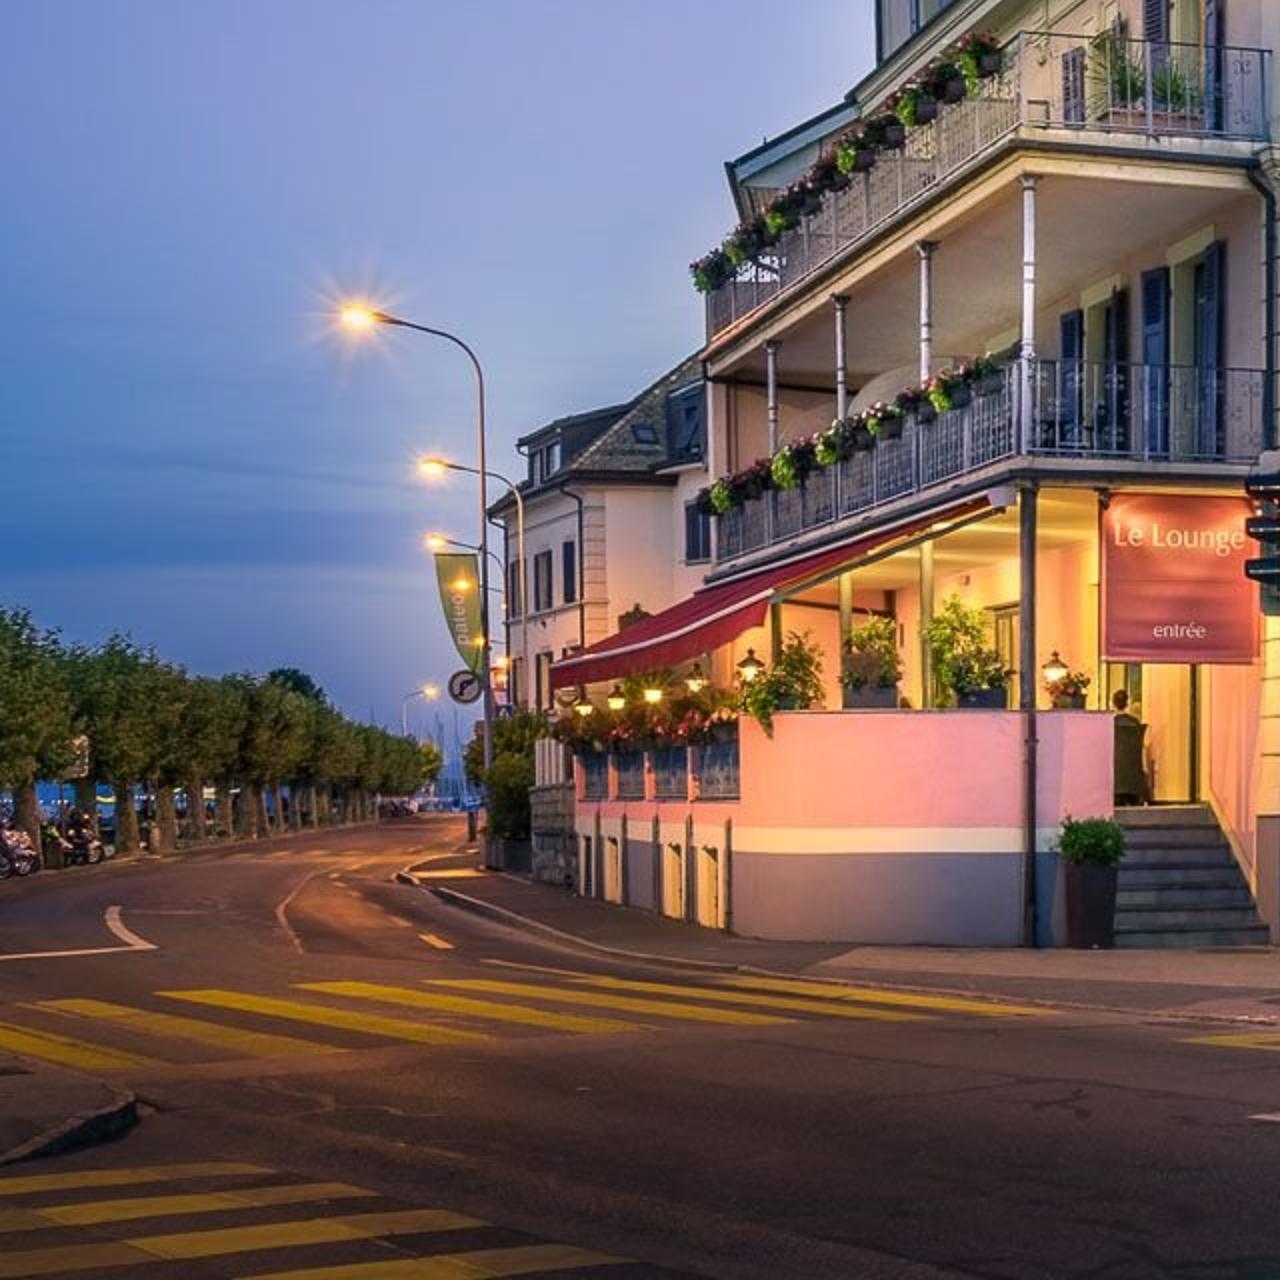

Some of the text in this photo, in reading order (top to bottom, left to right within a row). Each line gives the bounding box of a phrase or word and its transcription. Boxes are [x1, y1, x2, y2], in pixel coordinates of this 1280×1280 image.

[1114, 522, 1245, 557] Le Lounge
[1152, 621, 1207, 639] entrée
